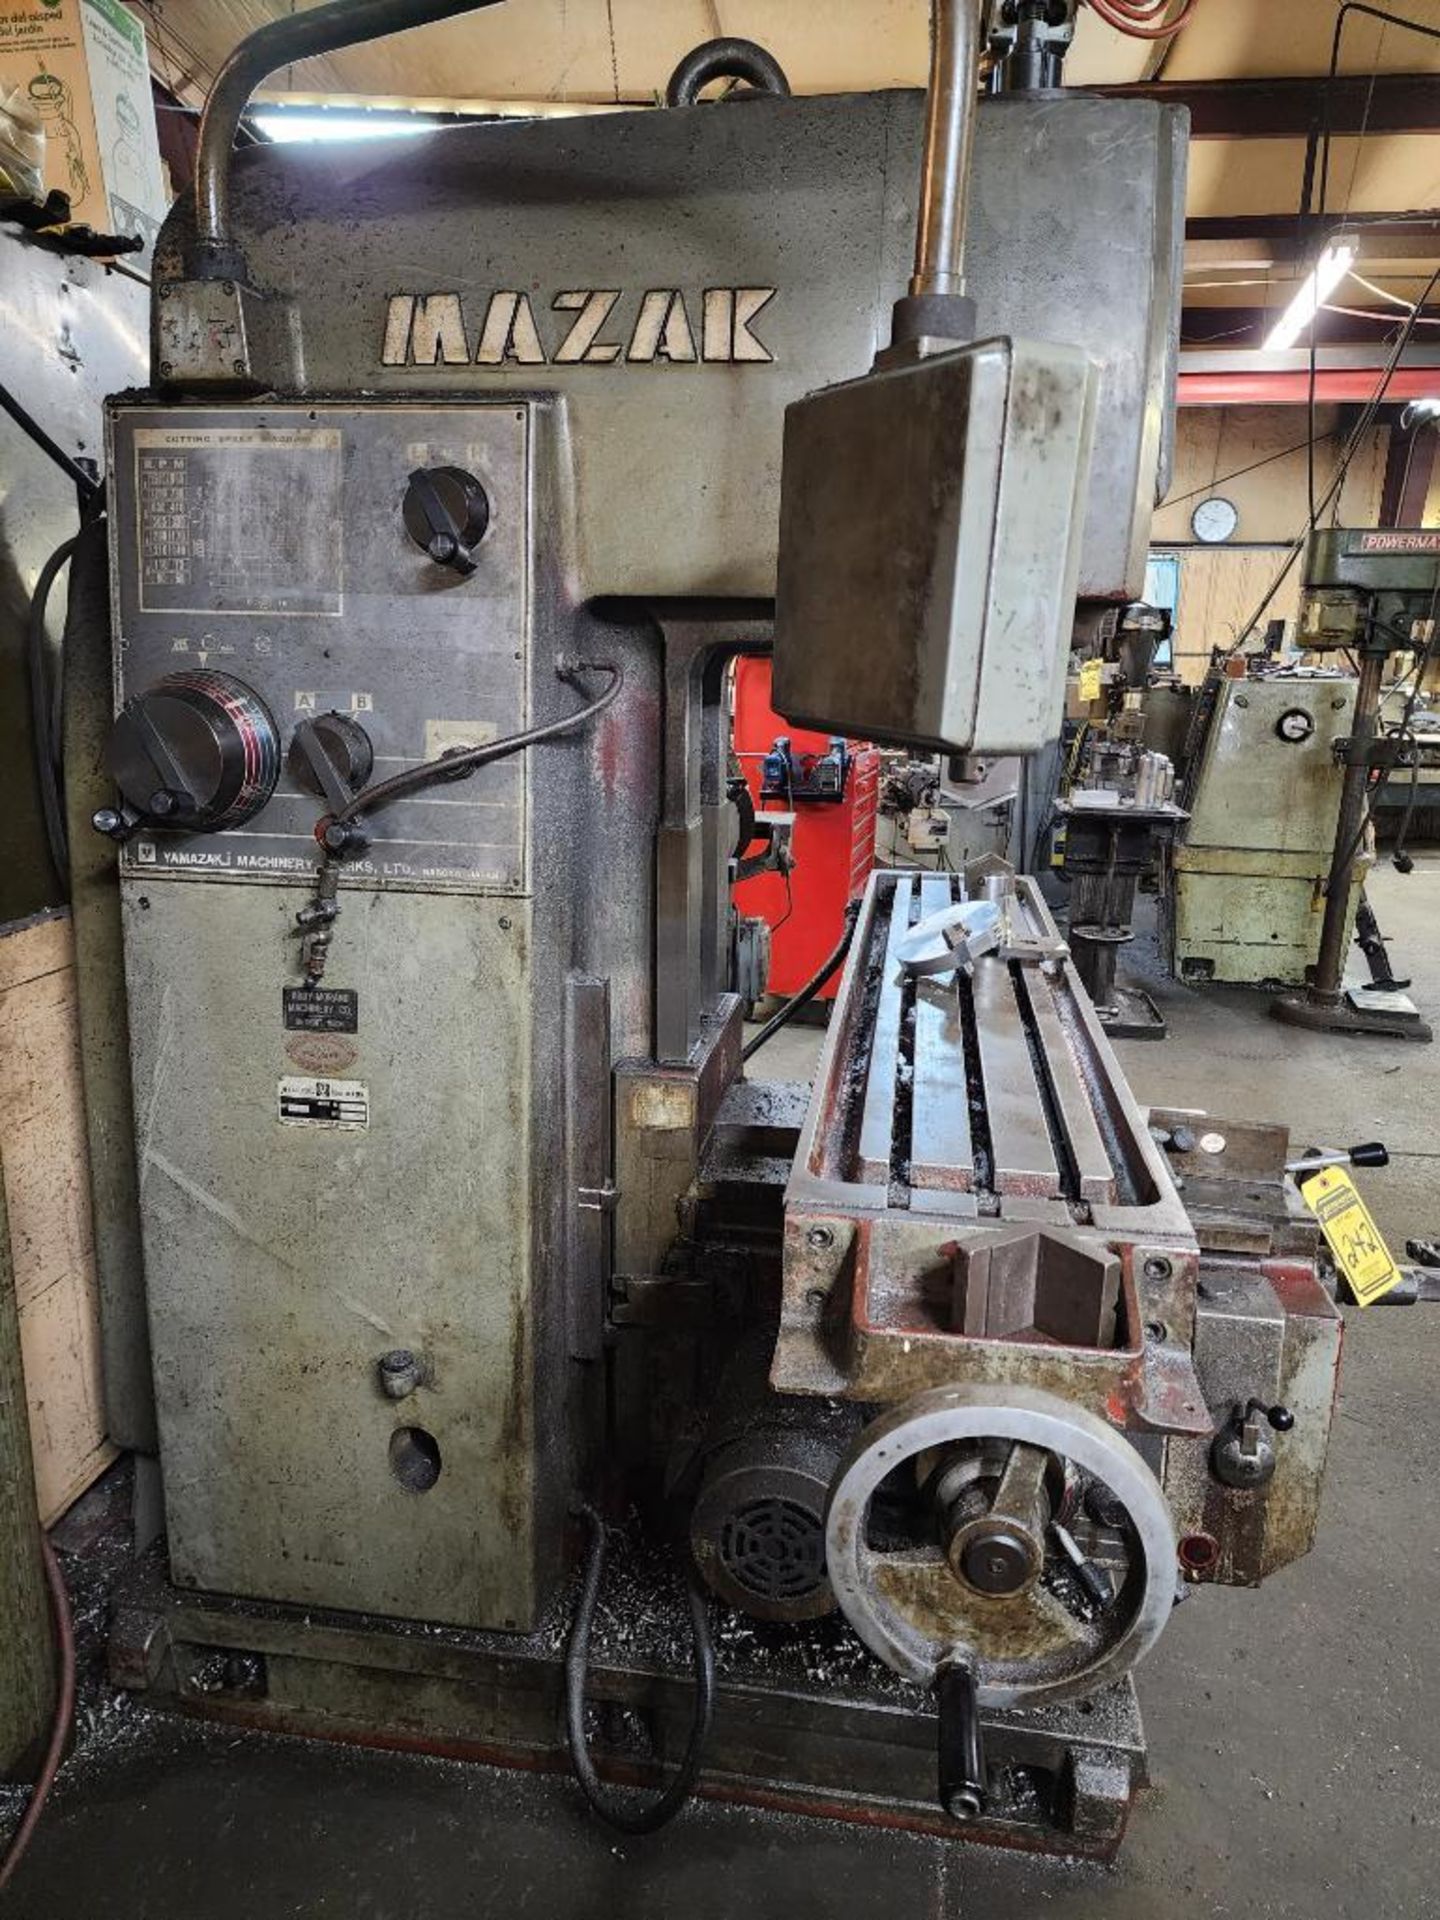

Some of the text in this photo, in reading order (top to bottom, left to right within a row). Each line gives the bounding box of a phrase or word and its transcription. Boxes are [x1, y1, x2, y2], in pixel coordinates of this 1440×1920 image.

[381, 287, 778, 365] MAZAK
[165, 435, 211, 444] CUTTING
[298, 694, 311, 707] A
[357, 696, 367, 709] B
[237, 855, 314, 870] MACHINERY
